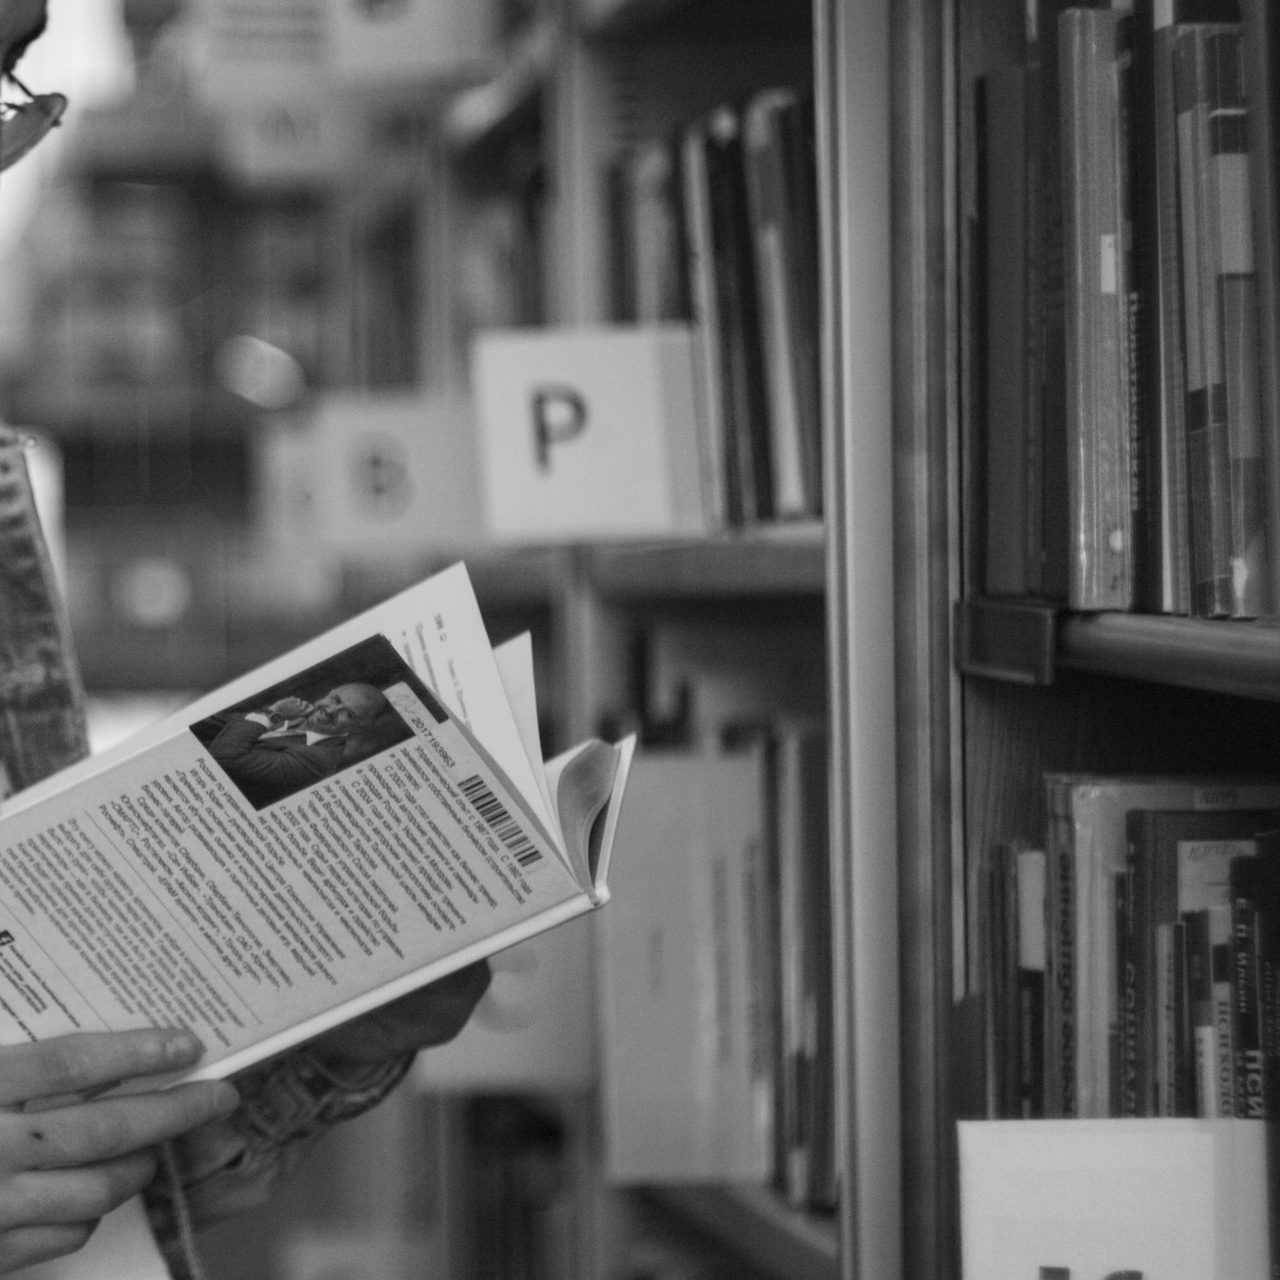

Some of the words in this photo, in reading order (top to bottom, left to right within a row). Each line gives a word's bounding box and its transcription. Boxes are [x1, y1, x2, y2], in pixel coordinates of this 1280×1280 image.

[531, 378, 591, 480] Р
[1128, 292, 1140, 511] Политическая
[410, 716, 457, 768] 2017193963
[135, 796, 158, 819] Среди
[152, 817, 181, 848] клиентов
[194, 757, 219, 783] России
[220, 790, 268, 843] управленческой
[304, 799, 324, 818] Член
[317, 816, 356, 859] Российского
[350, 856, 373, 880] Союза
[309, 789, 325, 804] ров
[320, 801, 356, 840] Владимира
[332, 798, 373, 844] руководителя
[368, 841, 404, 880] Таллинской
[397, 879, 420, 903] школы
[336, 784, 368, 818] семинары
[358, 773, 384, 801] городах
[379, 799, 406, 827] России,
[398, 825, 428, 855] Украины
[425, 858, 457, 892] Молдовы.
[364, 817, 375, 827] по
[365, 762, 403, 805] проводящий
[397, 803, 429, 838] авторские
[423, 836, 451, 867] тренинги
[450, 871, 481, 905] семинары
[369, 825, 402, 861] авторским
[387, 770, 407, 789] 2002
[400, 787, 418, 805] года
[413, 803, 431, 820] стал
[425, 818, 453, 849] известен
[448, 848, 462, 861] как
[398, 747, 431, 783] занимался
[426, 781, 466, 826] собственным
[459, 824, 489, 856] бизнесом
[411, 744, 460, 799] Управленческий
[454, 797, 471, 815] опыт
[516, 878, 534, 895] года
[162, 773, 191, 805] являются
[212, 835, 236, 860] оценка
[235, 864, 286, 922] консультирование
[281, 920, 317, 960] менеджеров
[313, 959, 339, 987] разного
[171, 803, 193, 824] Автор
[186, 823, 226, 868] развивающих
[255, 906, 282, 935] деловых
[288, 947, 317, 978] ведущий
[187, 768, 209, 790] Игорь
[204, 787, 227, 811] Зорин
[226, 817, 267, 862] руководитель
[262, 860, 288, 886] Центра
[282, 883, 318, 923] Психологии
[311, 921, 348, 960] Управления
[203, 805, 238, 844] основными
[232, 842, 277, 892] направлениями
[272, 891, 312, 935] деятельности
[307, 933, 335, 963] которого
[262, 823, 304, 871] региональных
[299, 868, 337, 911] чемпионатах
[336, 915, 374, 957] чемпионатах
[267, 809, 290, 834] ческой
[321, 877, 351, 909] арбитраж
[349, 913, 381, 948] судейство
[282, 809, 301, 828] 2002
[308, 843, 331, 865] Судья
[325, 863, 349, 888] первой
[344, 887, 374, 920] категории
[293, 804, 313, 823] Член
[307, 822, 342, 860] Федерации
[334, 857, 382, 911] управленческой
[376, 909, 402, 935] борьбы
[354, 786, 374, 805] 2004
[367, 803, 384, 820] года
[380, 819, 394, 832] как
[388, 831, 420, 866] лицензиат
[415, 864, 444, 896] проводит
[439, 894, 468, 925] тренинги
[396, 860, 433, 901] технологиям
[202, 931, 225, 955] многие
[234, 934, 253, 952] ОАО
